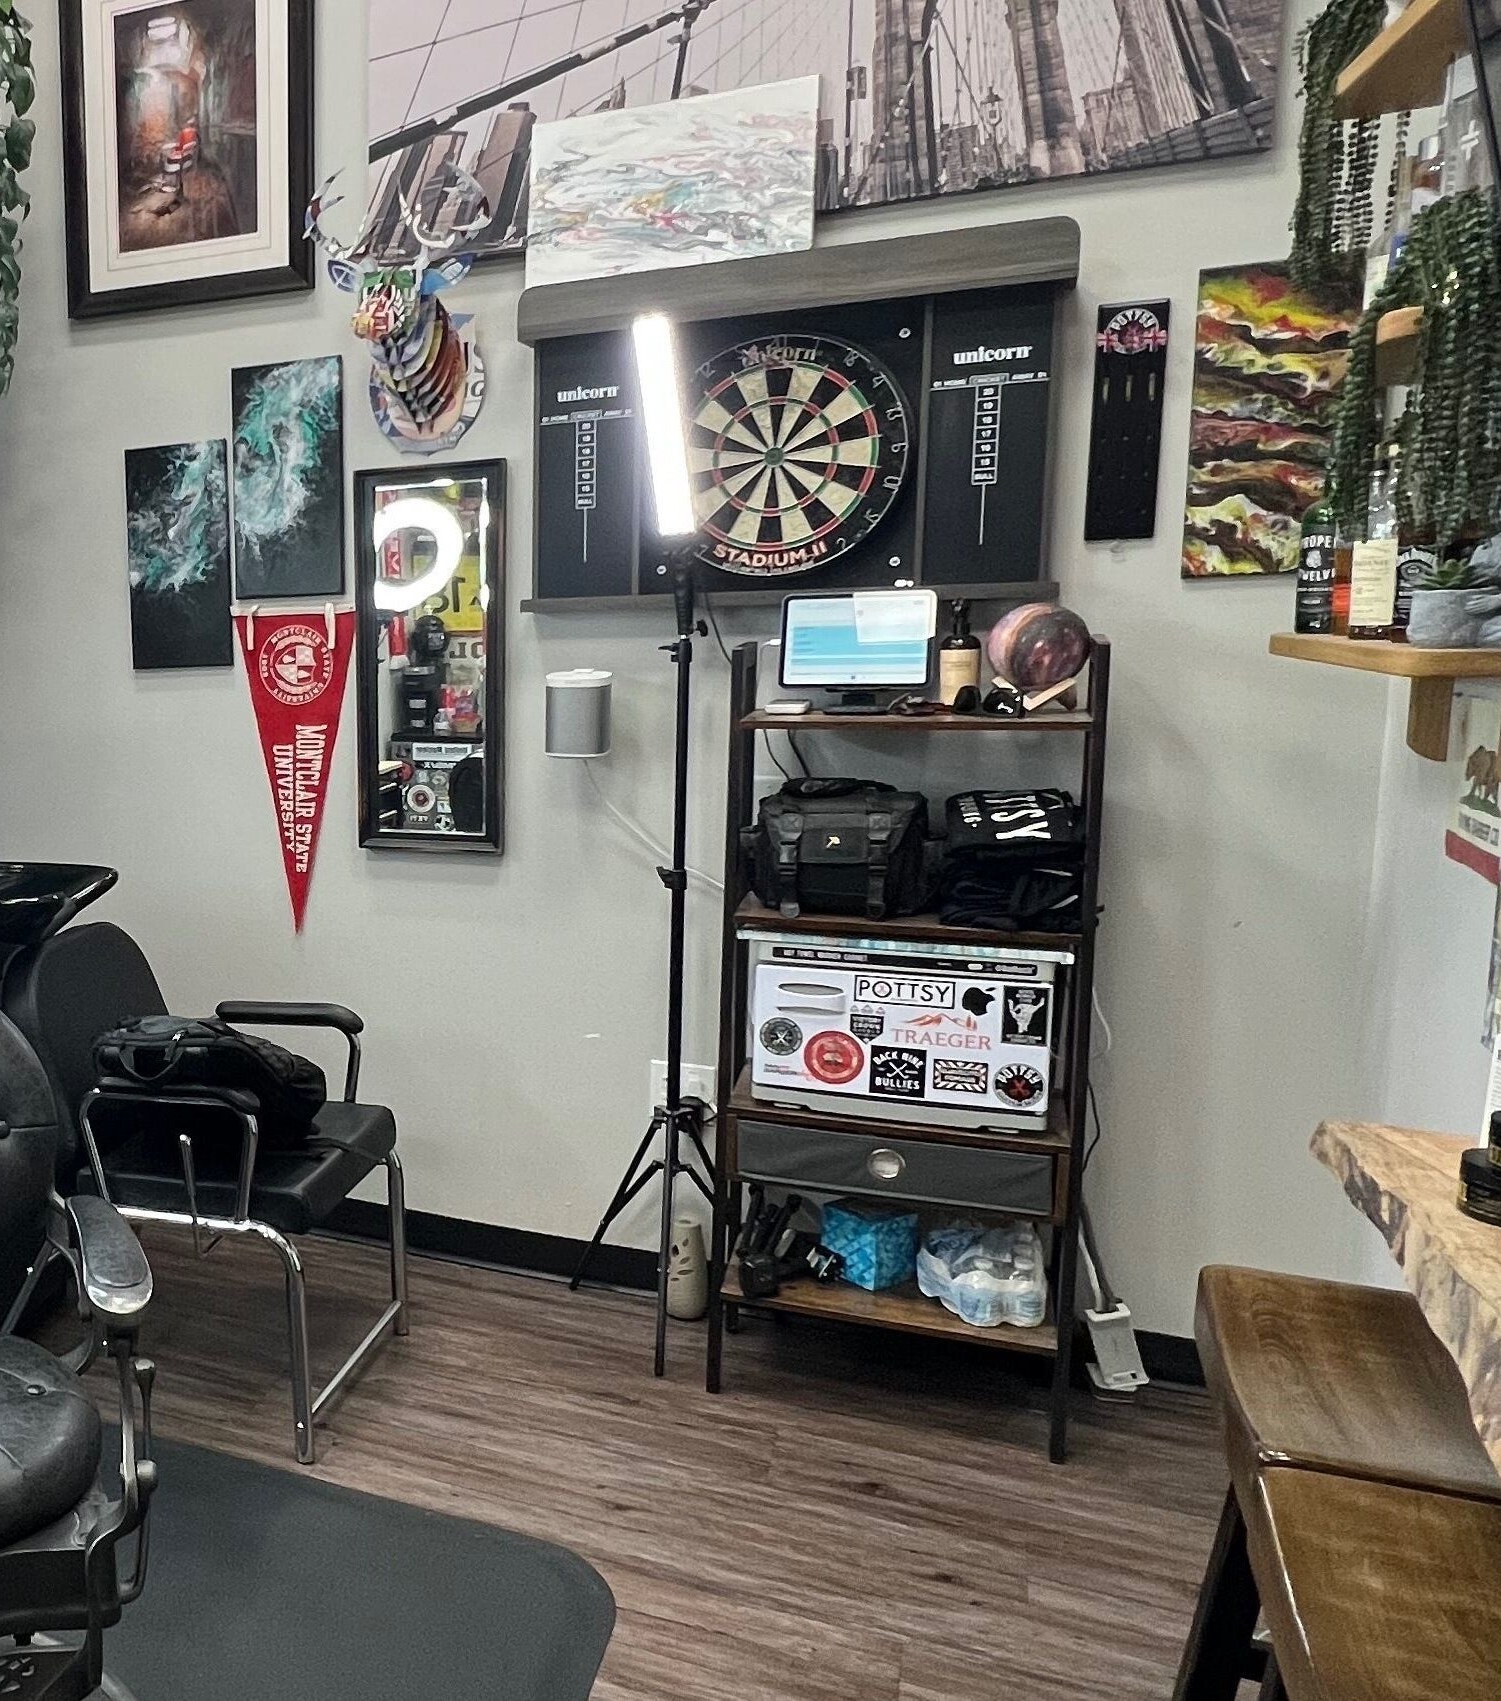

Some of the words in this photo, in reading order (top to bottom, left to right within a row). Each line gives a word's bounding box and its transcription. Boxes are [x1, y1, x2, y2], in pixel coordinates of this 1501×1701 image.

[953, 346, 1033, 365] unicorn
[557, 386, 619, 402] unicorn
[1302, 535, 1337, 549] ROPE
[712, 543, 807, 568] STADIUM
[1300, 567, 1337, 582] WELV
[295, 724, 328, 818] MONTCLAIR
[272, 743, 295, 852] UNIVERSITY
[295, 823, 313, 873] STATE
[858, 979, 950, 1003] POTTSY
[890, 1028, 992, 1050] TRAEGER
[874, 1076, 921, 1090] BULLIES
